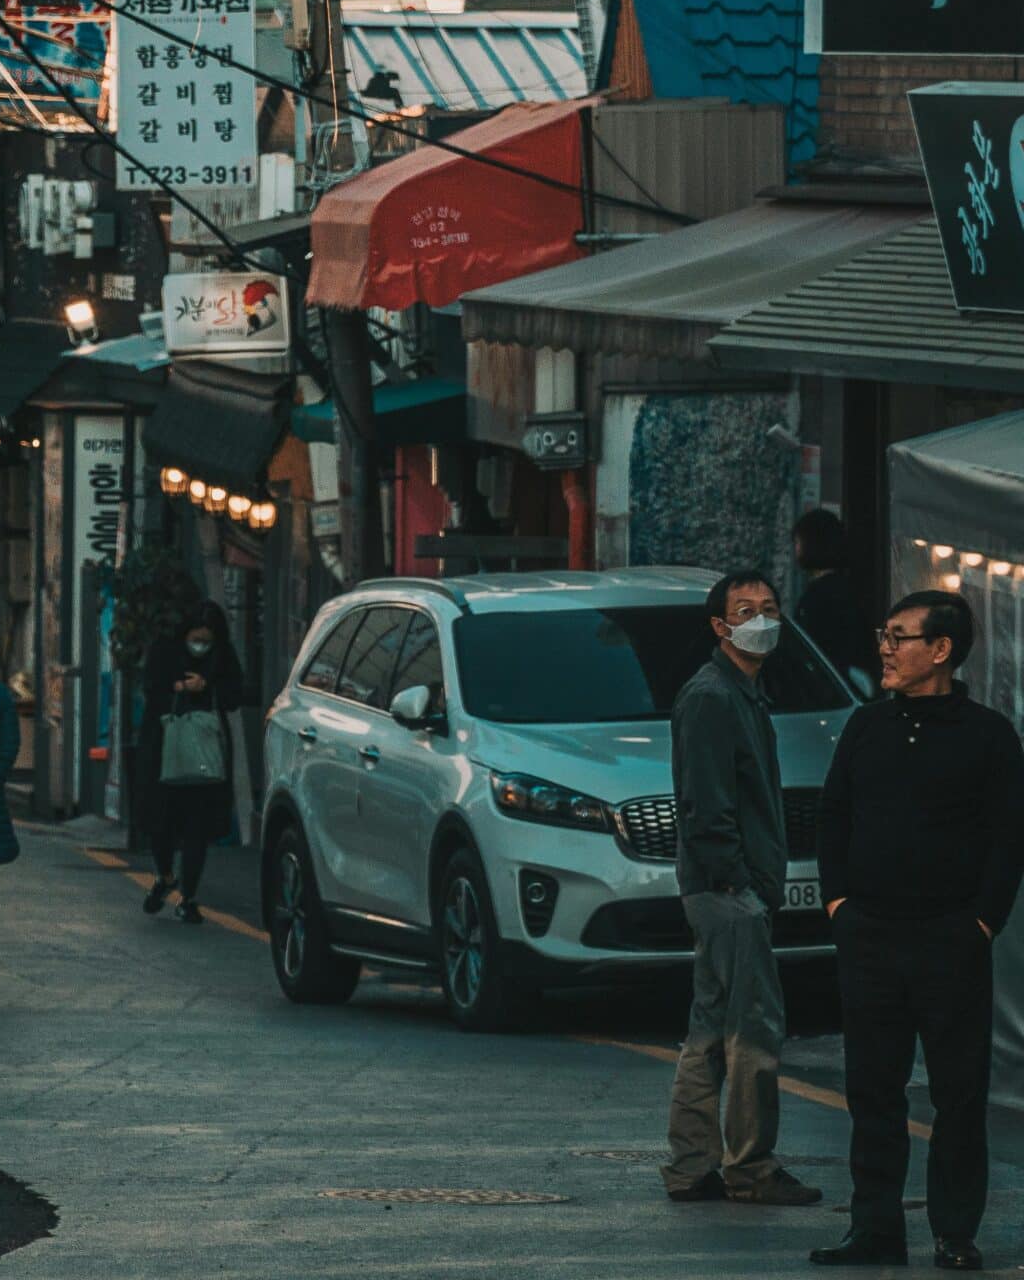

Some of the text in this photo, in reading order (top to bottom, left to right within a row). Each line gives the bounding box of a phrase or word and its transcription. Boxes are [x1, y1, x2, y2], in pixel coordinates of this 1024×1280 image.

[137, 81, 233, 106] 갈비찜
[139, 118, 237, 143] 갈비탕
[126, 166, 252, 185] T.723-3911
